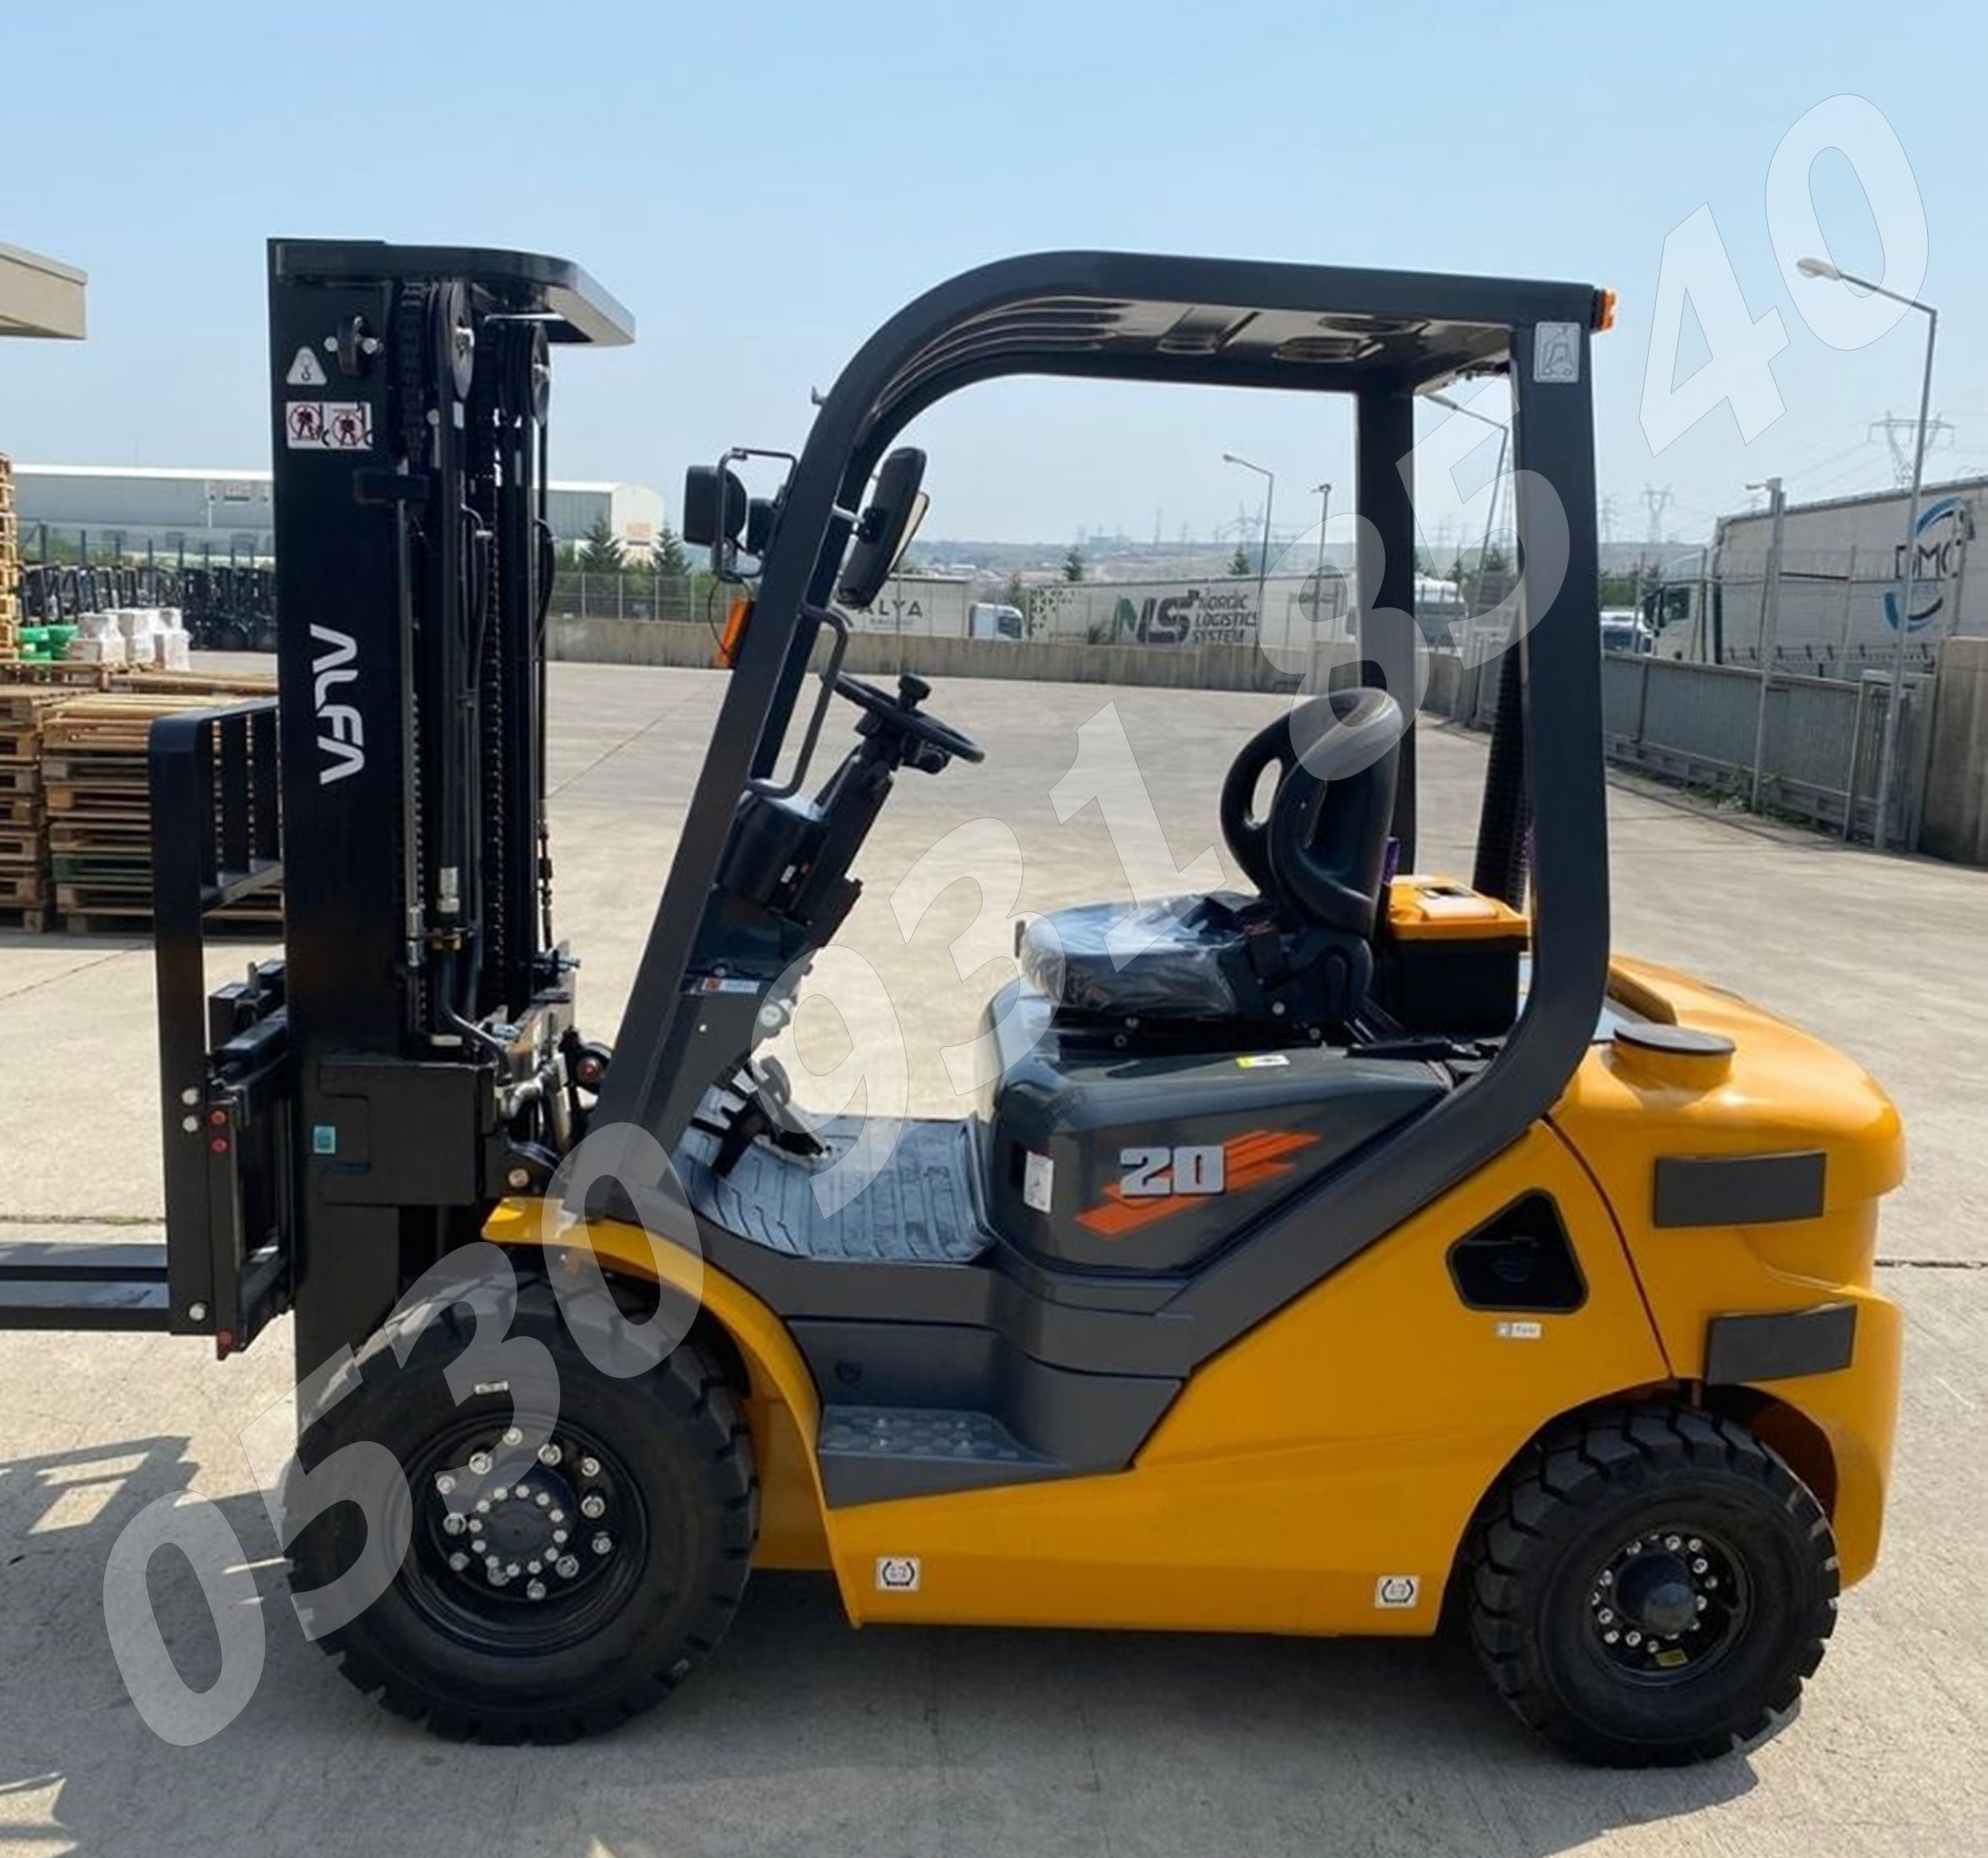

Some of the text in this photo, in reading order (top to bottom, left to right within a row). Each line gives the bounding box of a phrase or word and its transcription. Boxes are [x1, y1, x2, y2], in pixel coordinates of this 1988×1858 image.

[1194, 610, 1258, 628] LOGISTICS
[1191, 629, 1245, 644] SYSTEM
[309, 623, 365, 785] ALFA
[1119, 1145, 1224, 1196] 20
